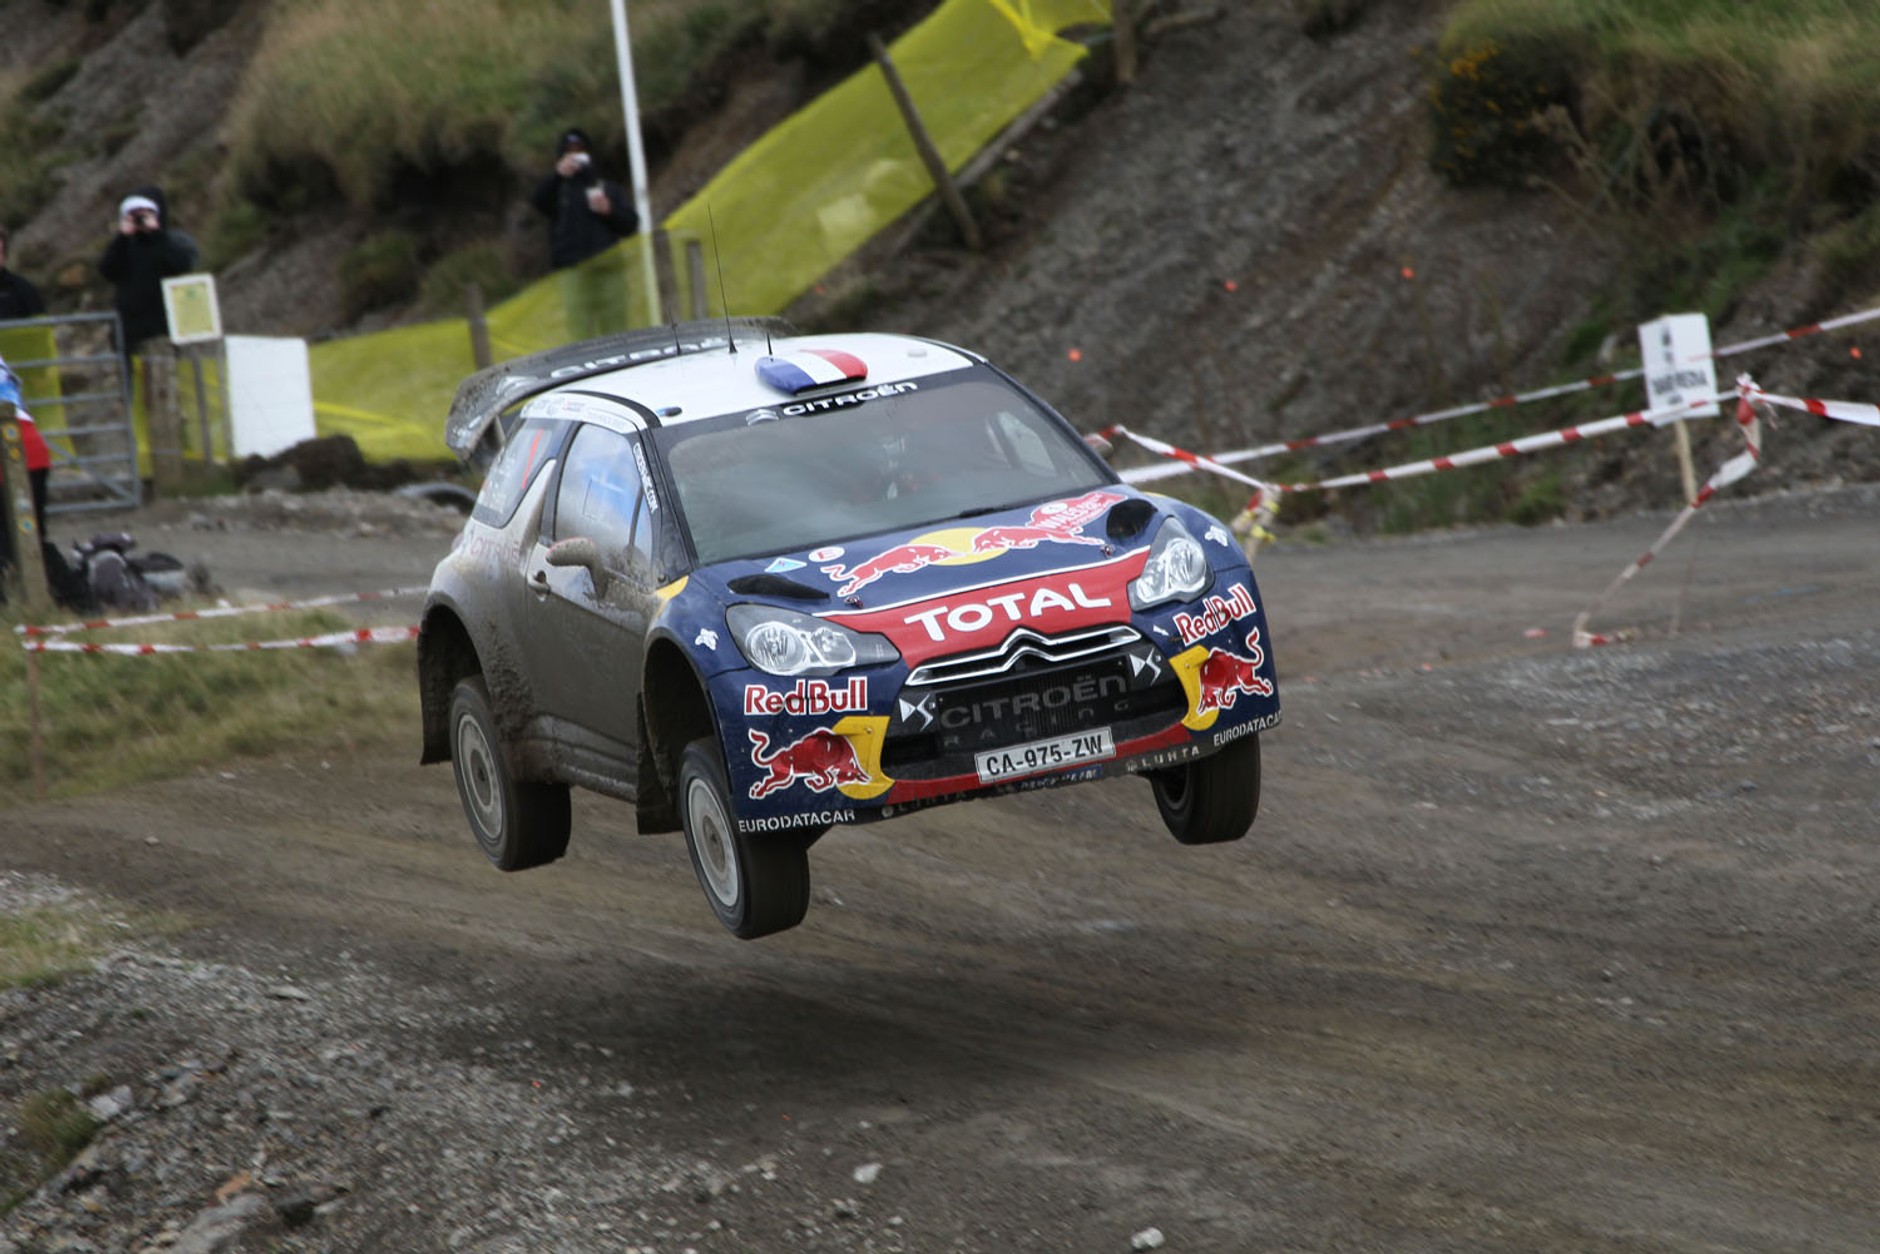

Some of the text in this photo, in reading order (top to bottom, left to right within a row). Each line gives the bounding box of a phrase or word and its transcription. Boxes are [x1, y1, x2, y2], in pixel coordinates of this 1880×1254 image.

[904, 583, 1112, 642] TOTAL
[986, 734, 1103, 776] CA-975-ZW
[1142, 746, 1200, 767] LUHTA
[738, 809, 856, 833] EURODATACAR
